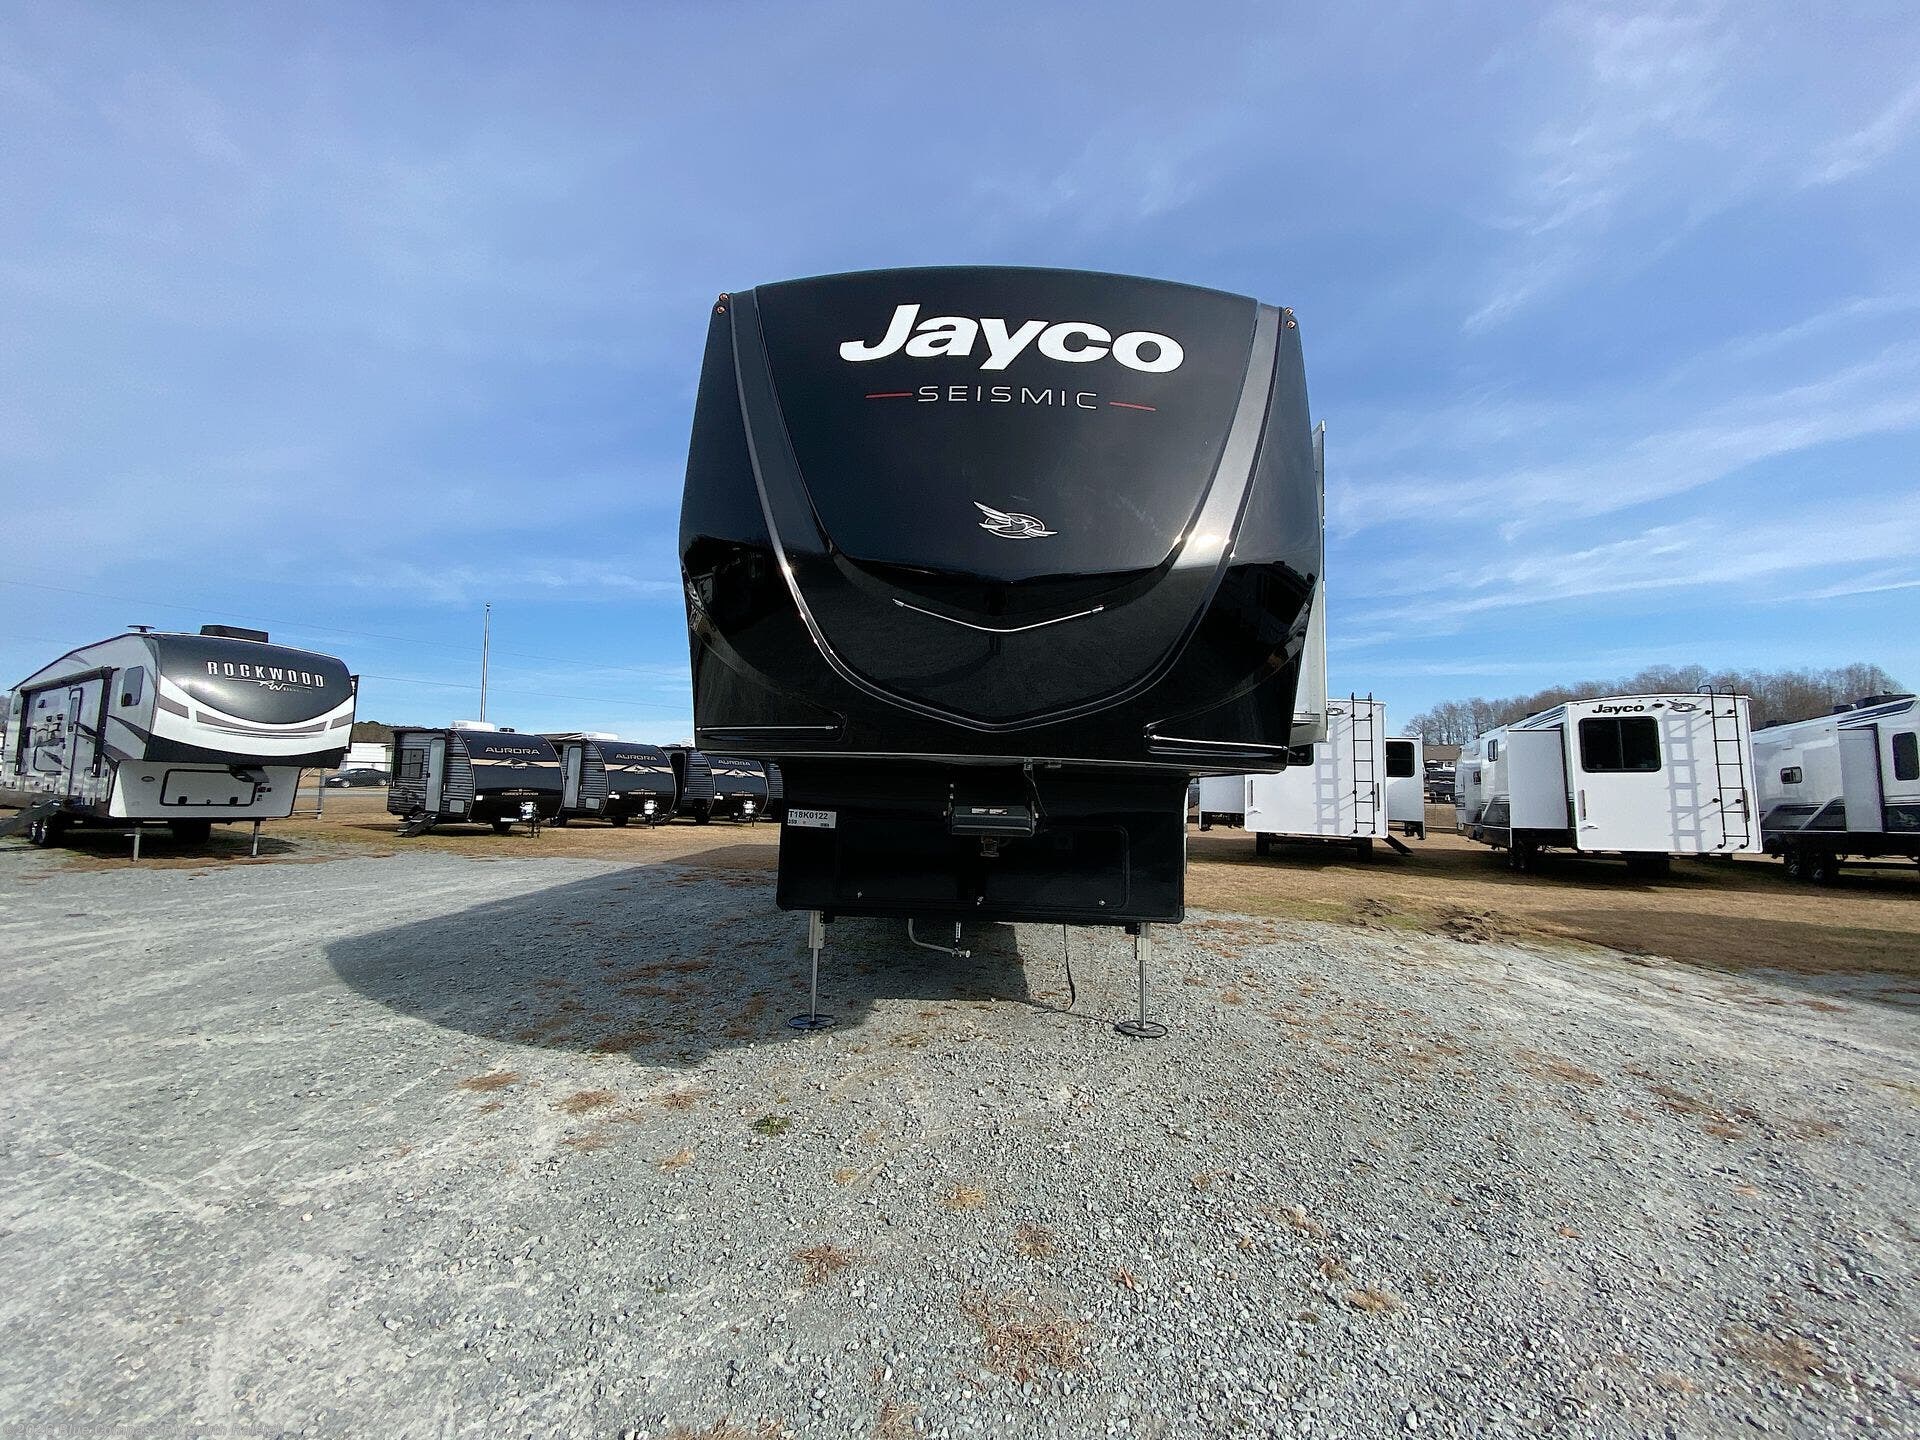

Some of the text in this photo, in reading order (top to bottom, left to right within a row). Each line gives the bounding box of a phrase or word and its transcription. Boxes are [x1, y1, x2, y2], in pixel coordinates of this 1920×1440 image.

[839, 303, 1185, 373] Jayco
[918, 385, 1098, 410] SEISMIC
[207, 661, 325, 688] ROCKWOOD
[1592, 704, 1645, 715] Jayco
[485, 746, 541, 755] AURORA
[615, 753, 658, 761] AURORA
